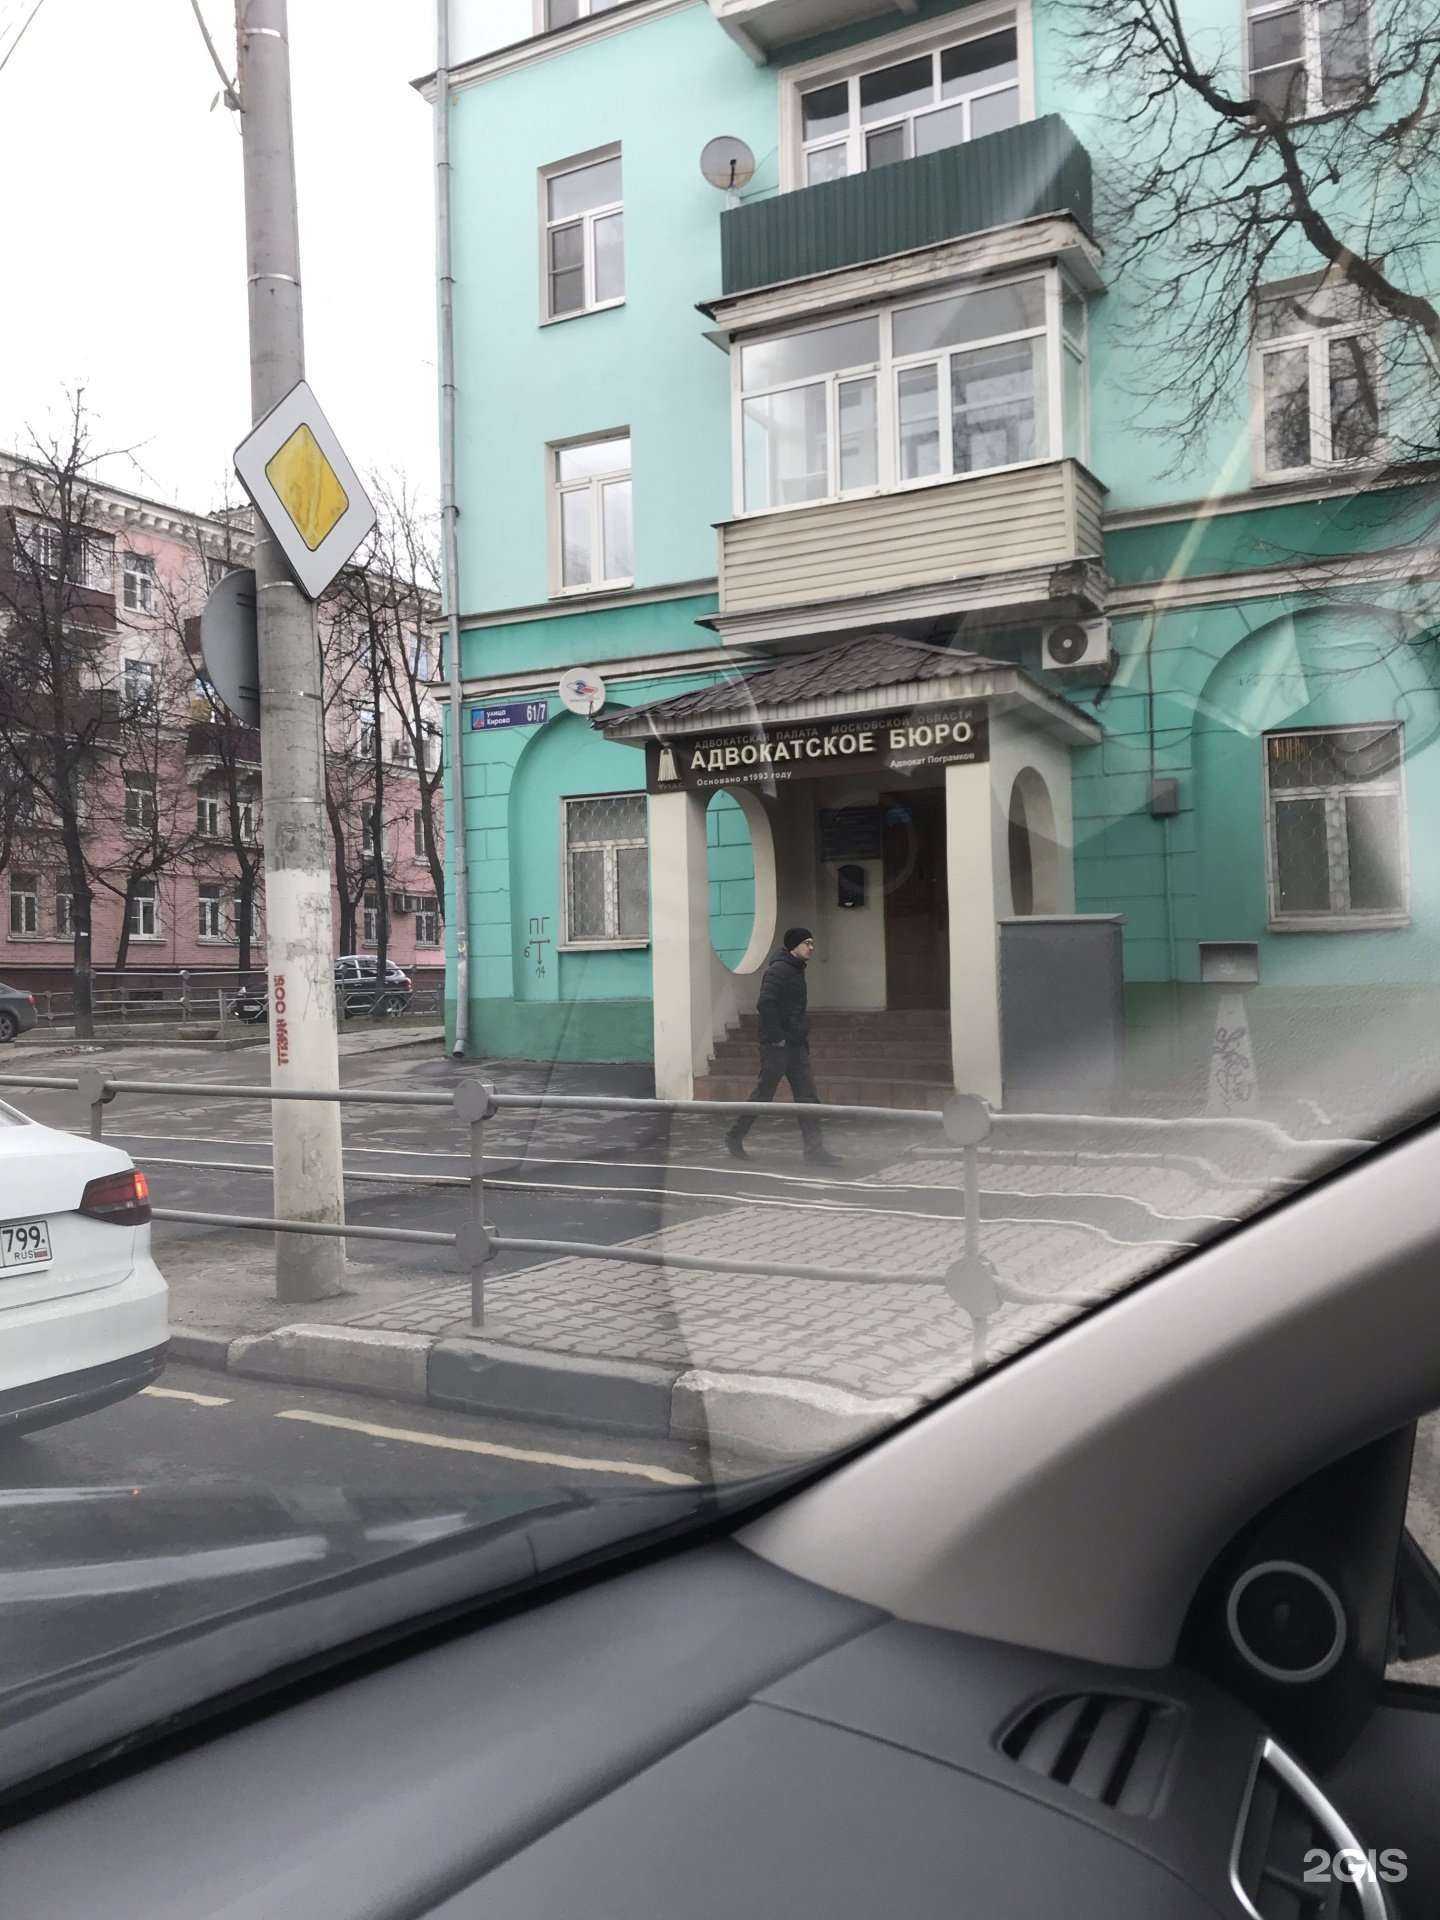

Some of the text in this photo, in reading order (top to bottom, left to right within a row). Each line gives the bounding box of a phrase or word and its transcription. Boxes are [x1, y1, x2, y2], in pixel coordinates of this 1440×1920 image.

[526, 702, 546, 722] 61/7
[486, 717, 511, 726] Кирова
[690, 721, 972, 772] АДВОКАТСКОЕ БЮРО
[889, 756, 926, 768] Адвокат
[696, 776, 741, 786] Основано
[771, 770, 792, 780] году
[14, 1250, 34, 1260] RUS
